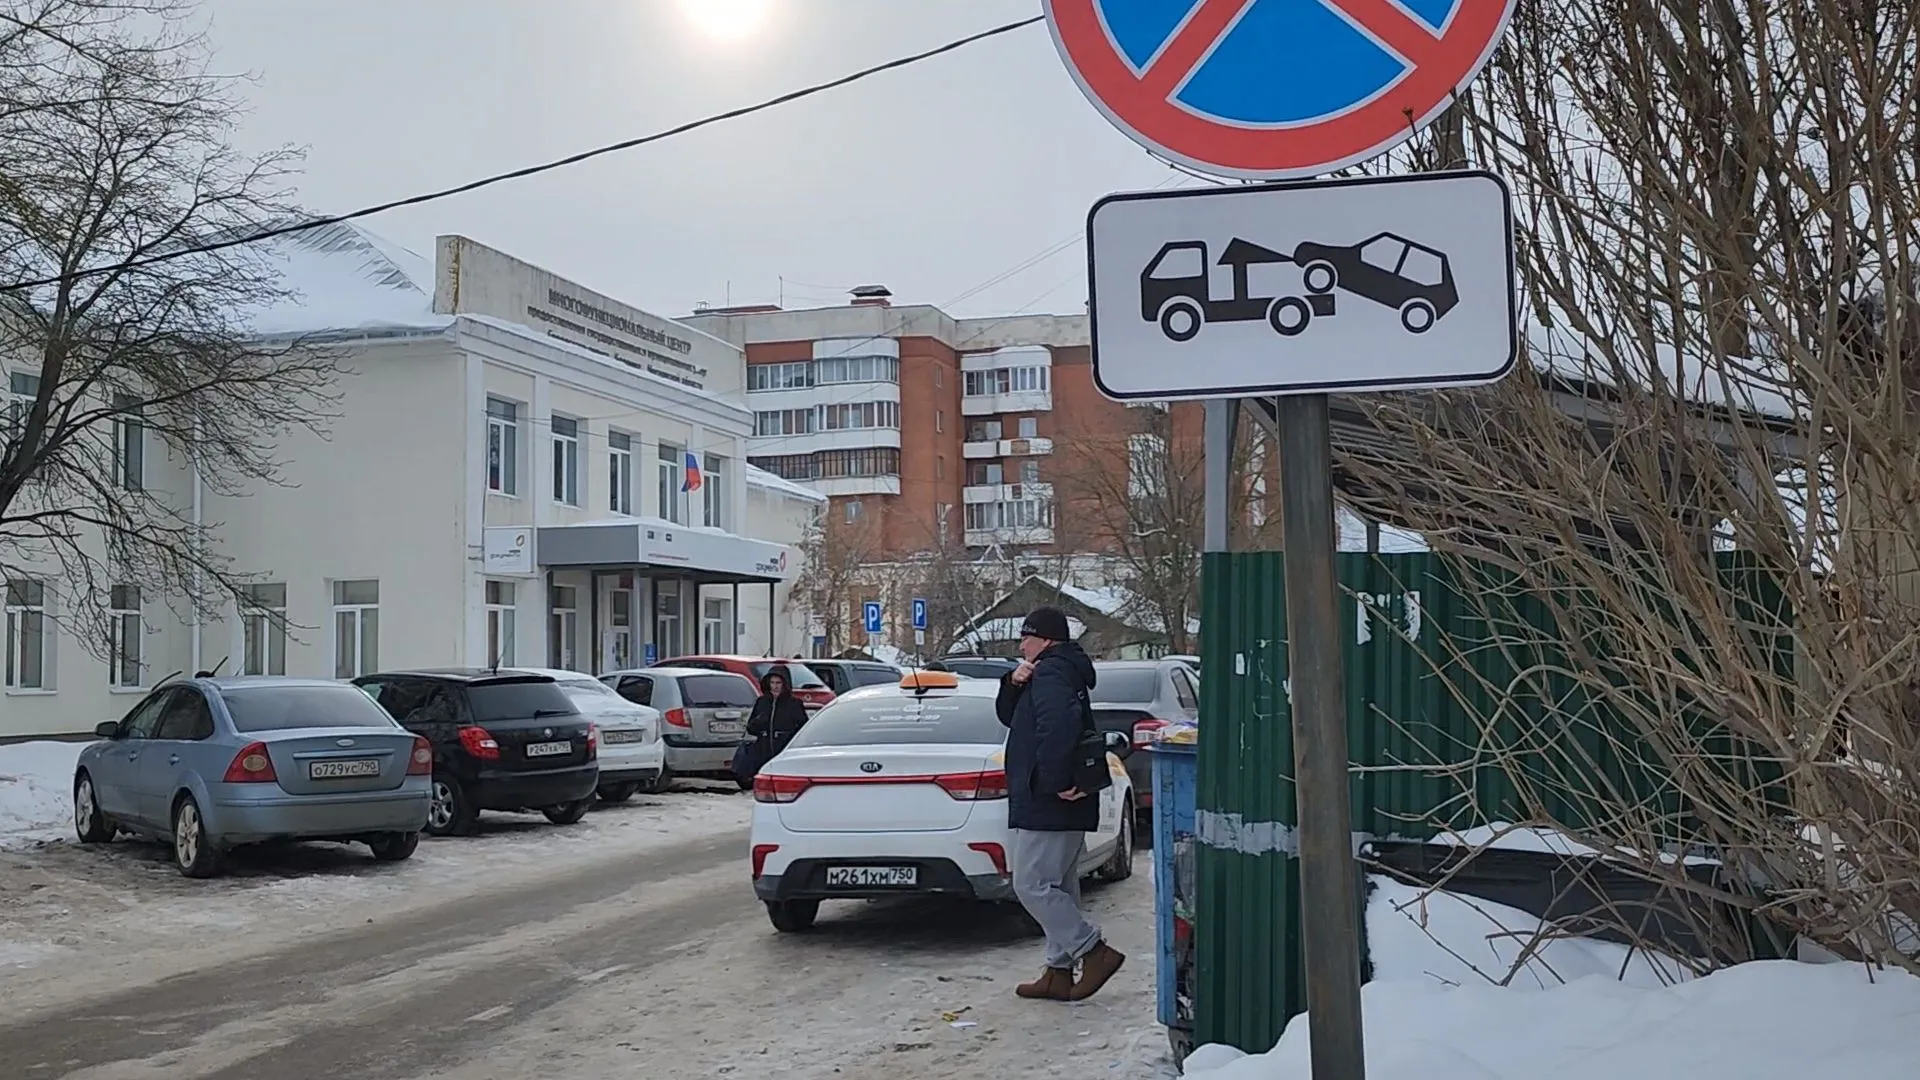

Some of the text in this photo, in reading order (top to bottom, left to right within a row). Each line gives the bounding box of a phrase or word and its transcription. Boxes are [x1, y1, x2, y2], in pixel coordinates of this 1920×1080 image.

[548, 288, 666, 347] МНОГОФУНКЦИОНАЛЬНЫЙ
[666, 335, 692, 355] ЦЕНТР
[868, 605, 878, 629] P
[915, 603, 923, 624] P
[862, 763, 880, 772] KIA
[830, 868, 889, 885] М261ХМ
